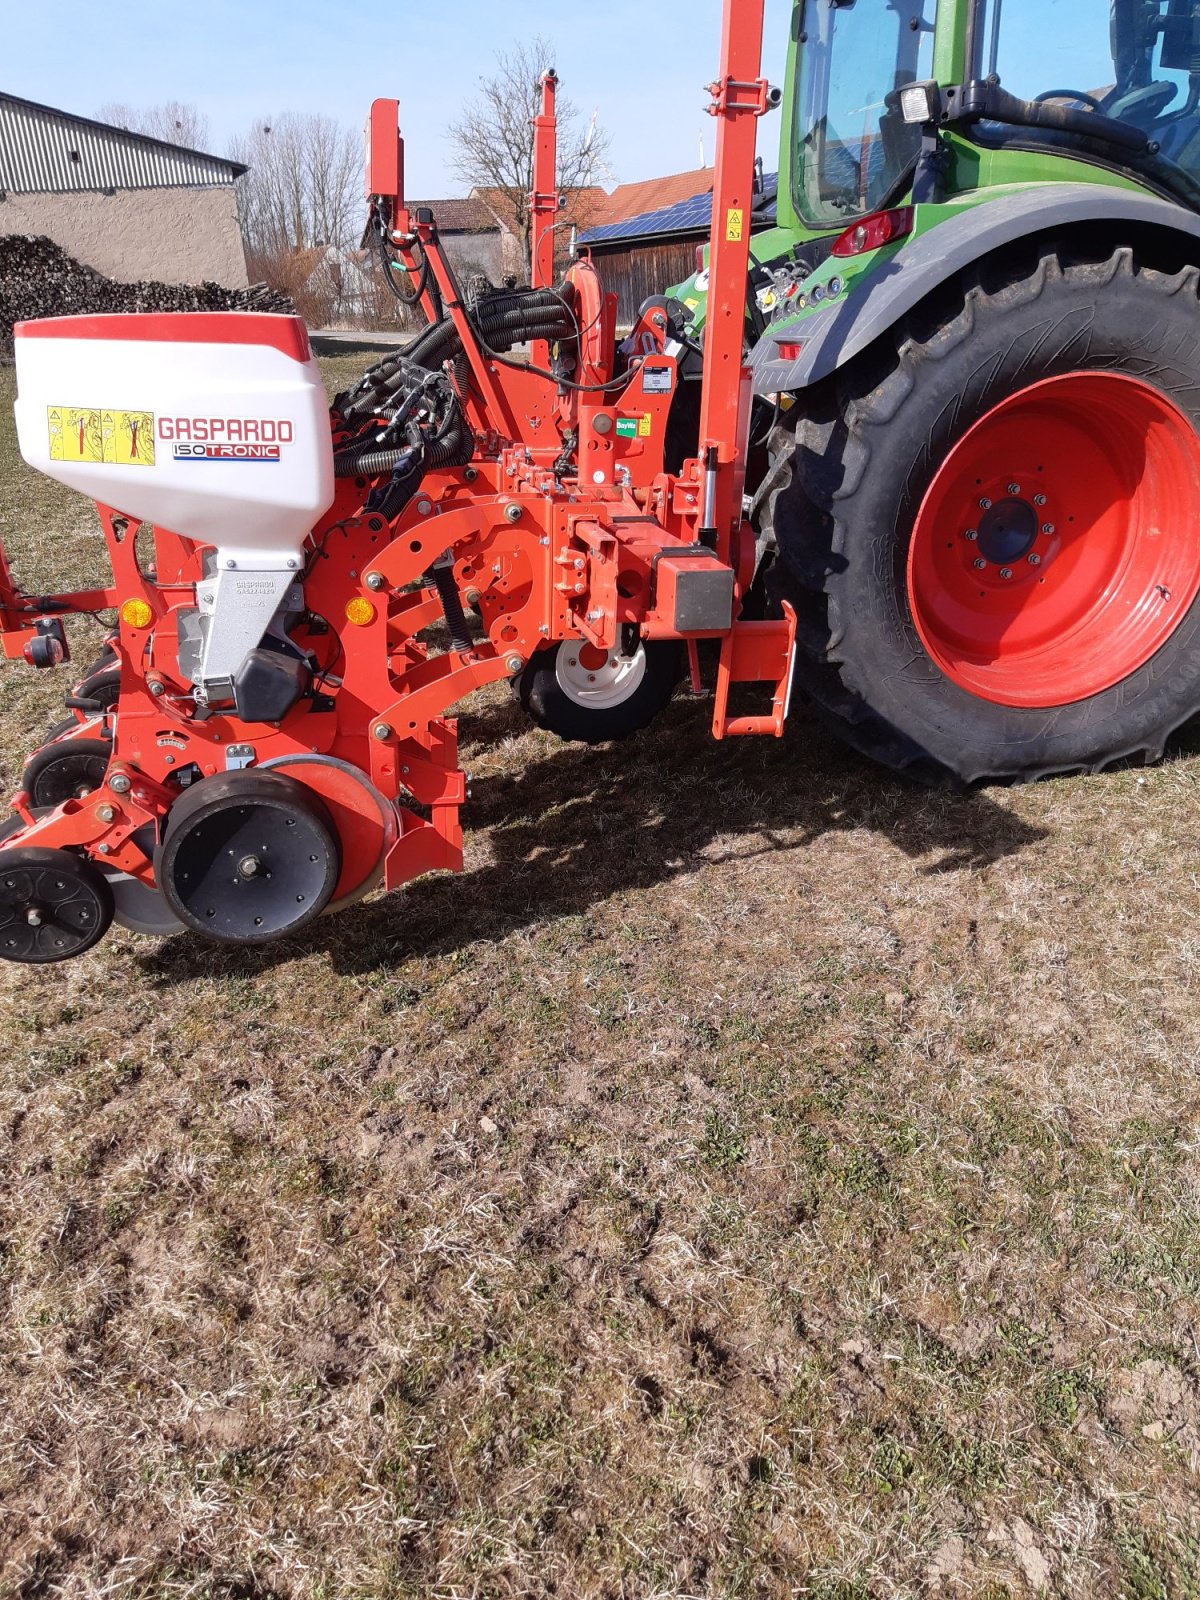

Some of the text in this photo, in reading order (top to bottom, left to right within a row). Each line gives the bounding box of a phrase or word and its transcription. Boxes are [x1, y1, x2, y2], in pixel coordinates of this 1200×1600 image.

[158, 417, 293, 442] GASPARDO
[617, 421, 636, 430] BayWa
[174, 444, 279, 457] ISOTRONIC
